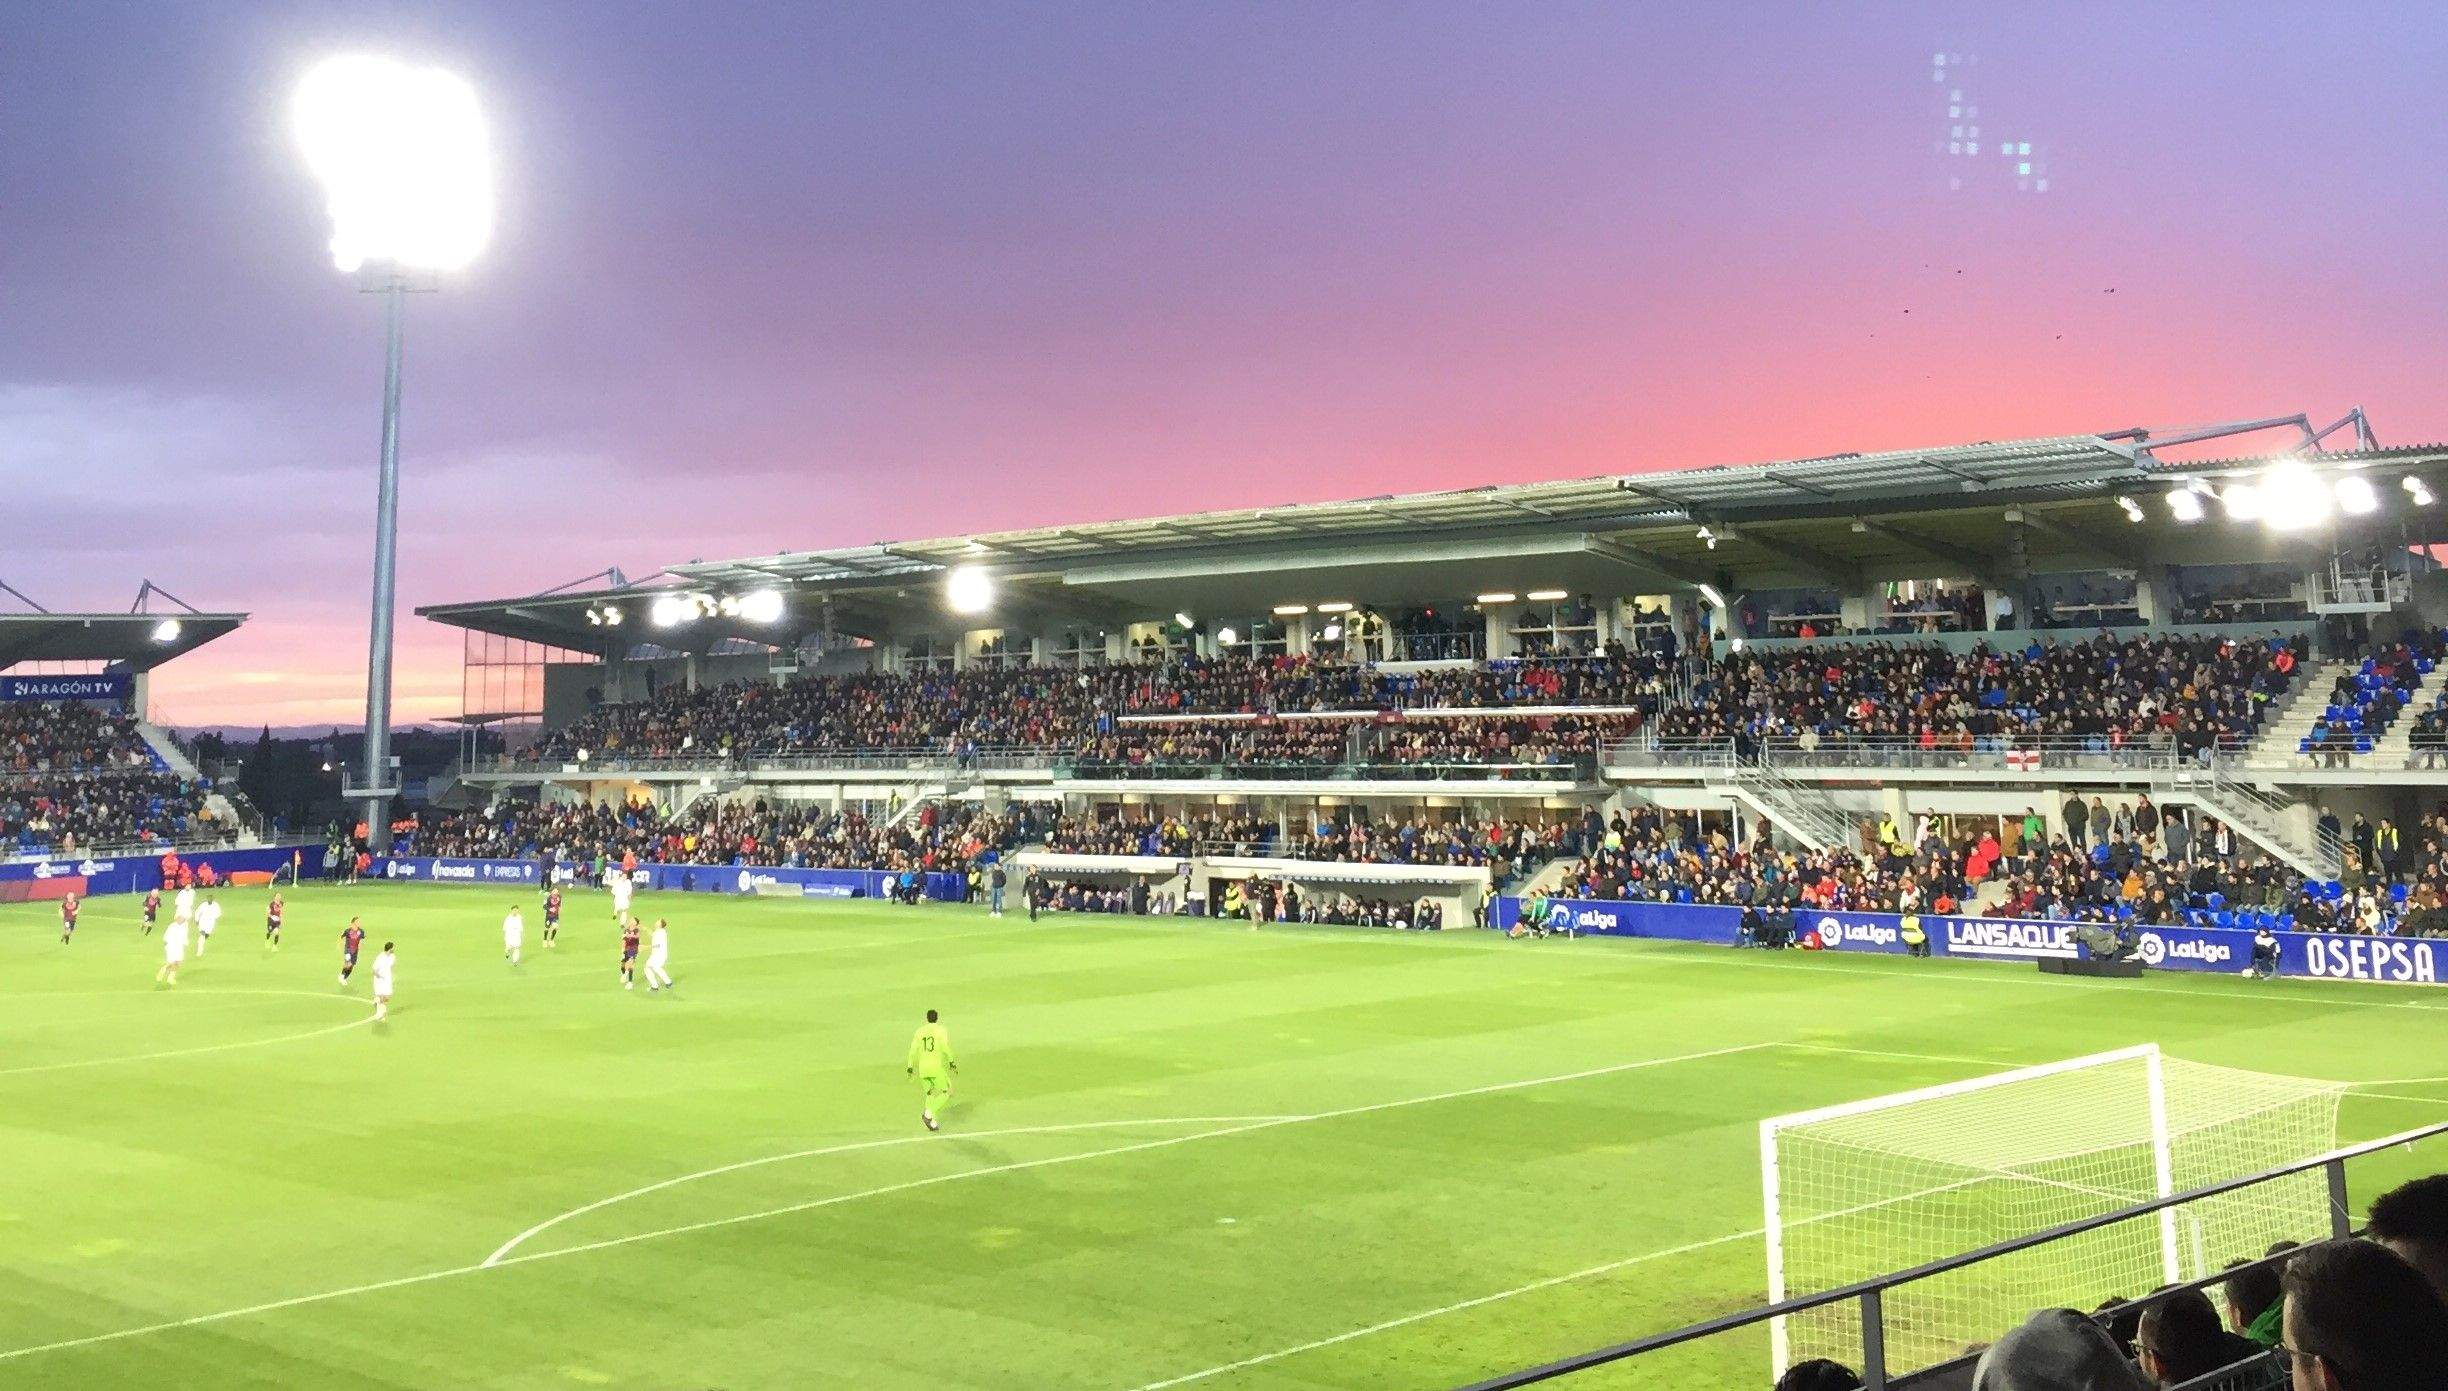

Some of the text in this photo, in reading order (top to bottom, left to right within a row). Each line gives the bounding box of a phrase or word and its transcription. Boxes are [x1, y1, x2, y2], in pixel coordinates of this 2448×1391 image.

[30, 680, 113, 695] ARAGÓN TV
[1579, 909, 1617, 930] aLiga
[1845, 923, 1896, 945] LaLiga
[1947, 921, 2078, 950] LANSAQUE
[2169, 939, 2230, 963] LaLiga
[2307, 937, 2435, 982] OSEPSA
[922, 1036, 935, 1052] 13
